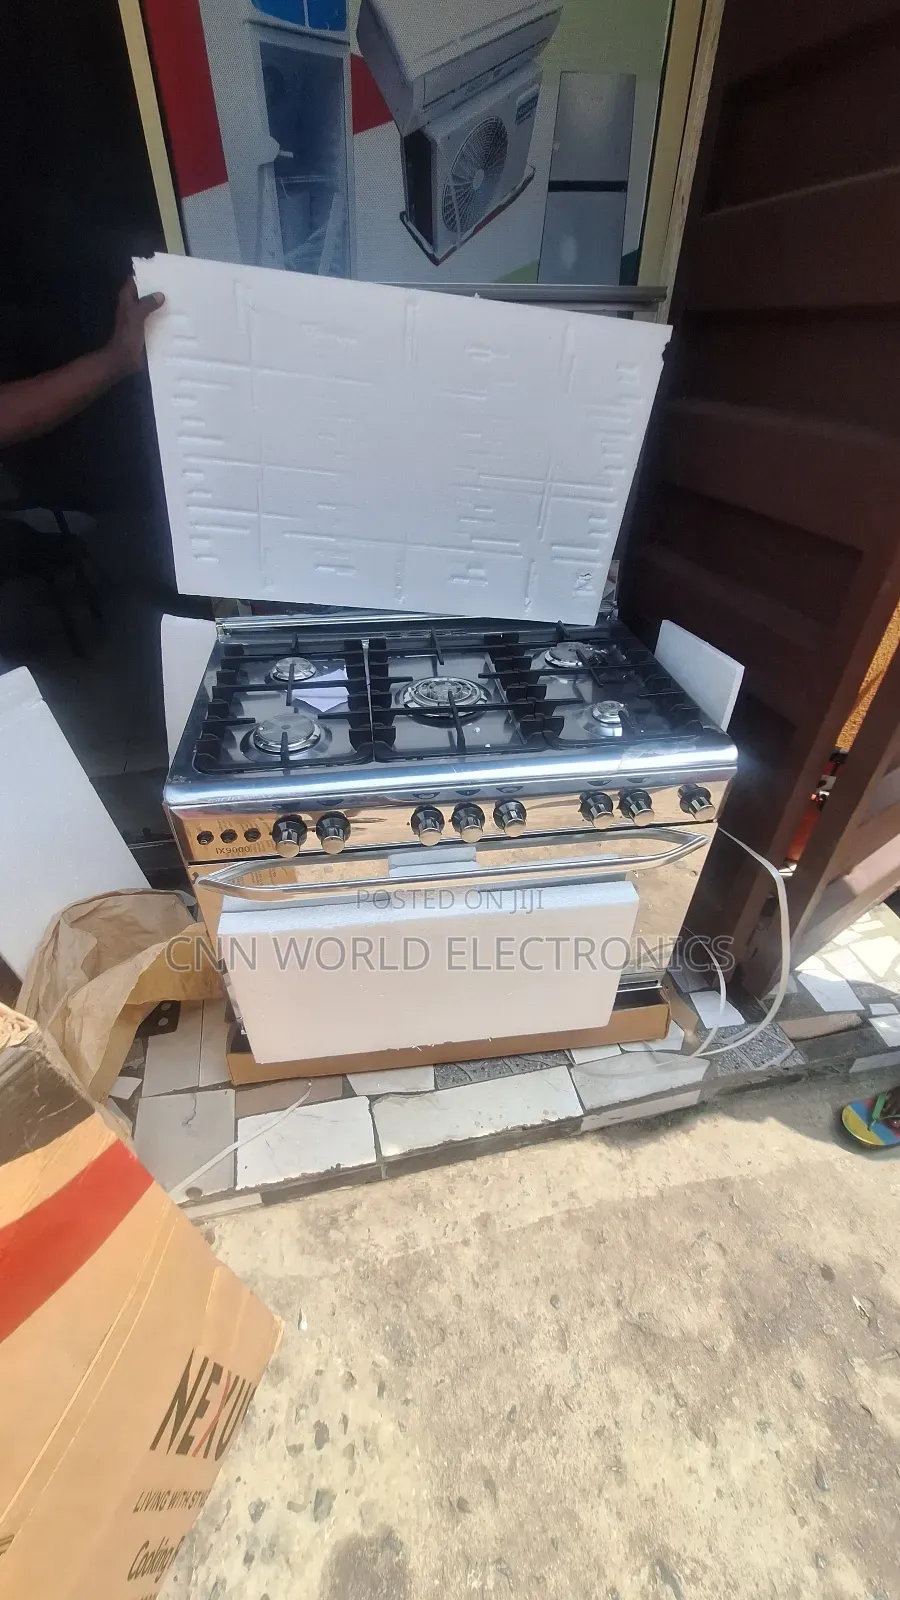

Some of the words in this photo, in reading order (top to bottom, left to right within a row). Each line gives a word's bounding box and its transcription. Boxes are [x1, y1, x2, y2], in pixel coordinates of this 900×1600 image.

[133, 1490, 171, 1513] LIVING
[167, 1490, 193, 1510] WITH
[127, 1536, 175, 1584] Cooking
